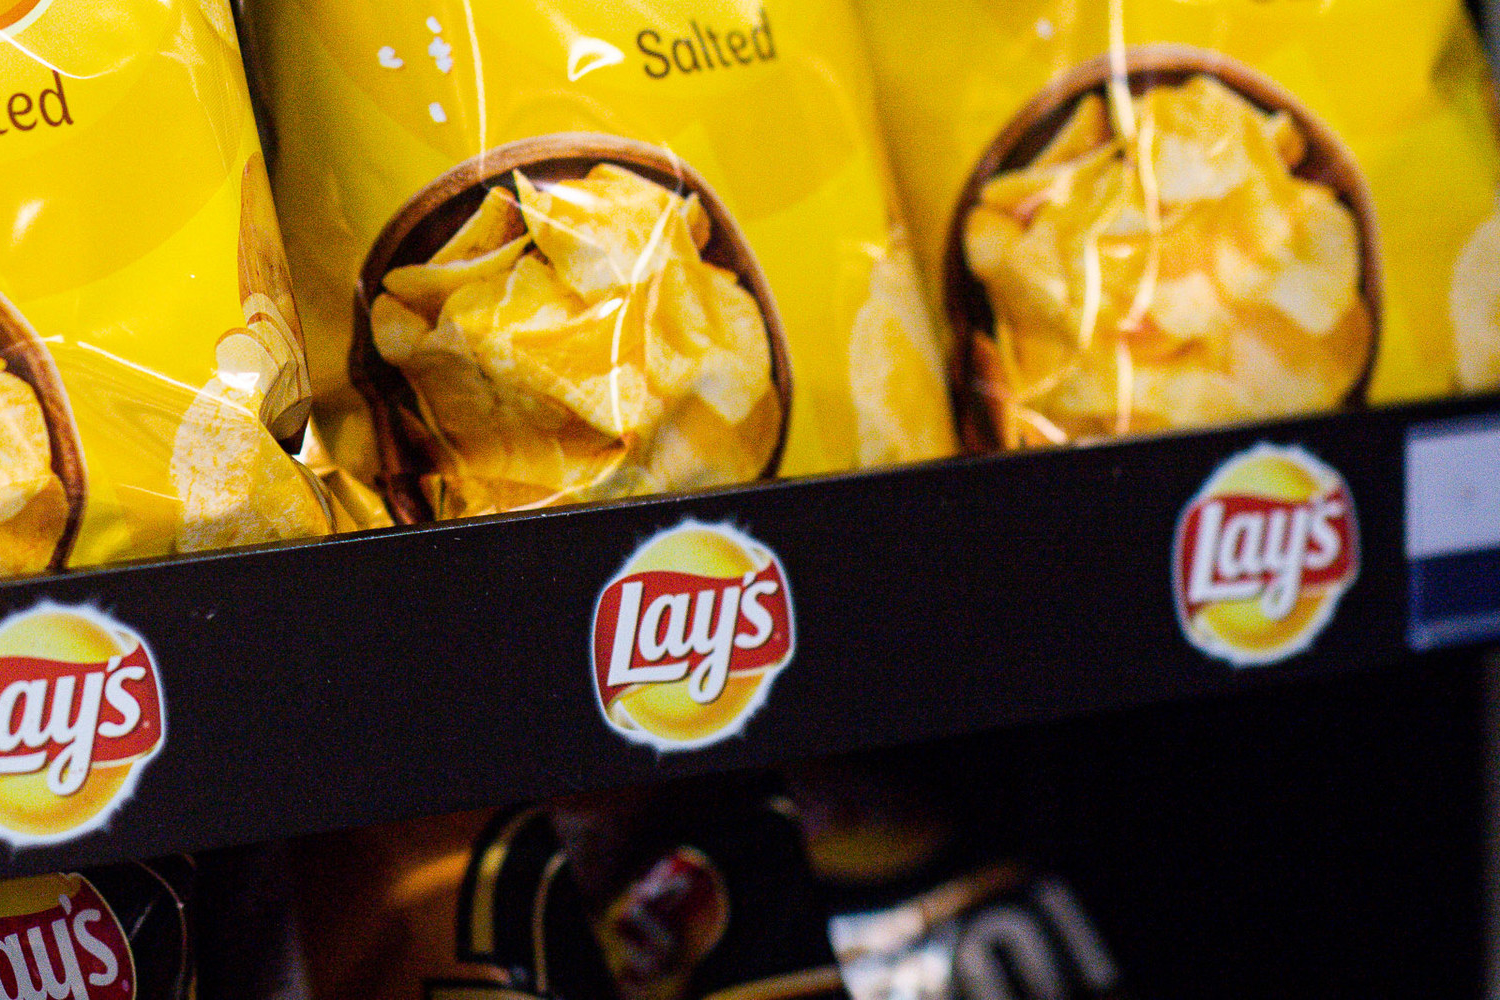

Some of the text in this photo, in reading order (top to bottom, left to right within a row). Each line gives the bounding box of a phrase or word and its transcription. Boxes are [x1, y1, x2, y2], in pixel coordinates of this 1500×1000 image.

[636, 7, 778, 80] Salted
[1190, 485, 1342, 619] Lay's
[607, 571, 778, 704] Lay's
